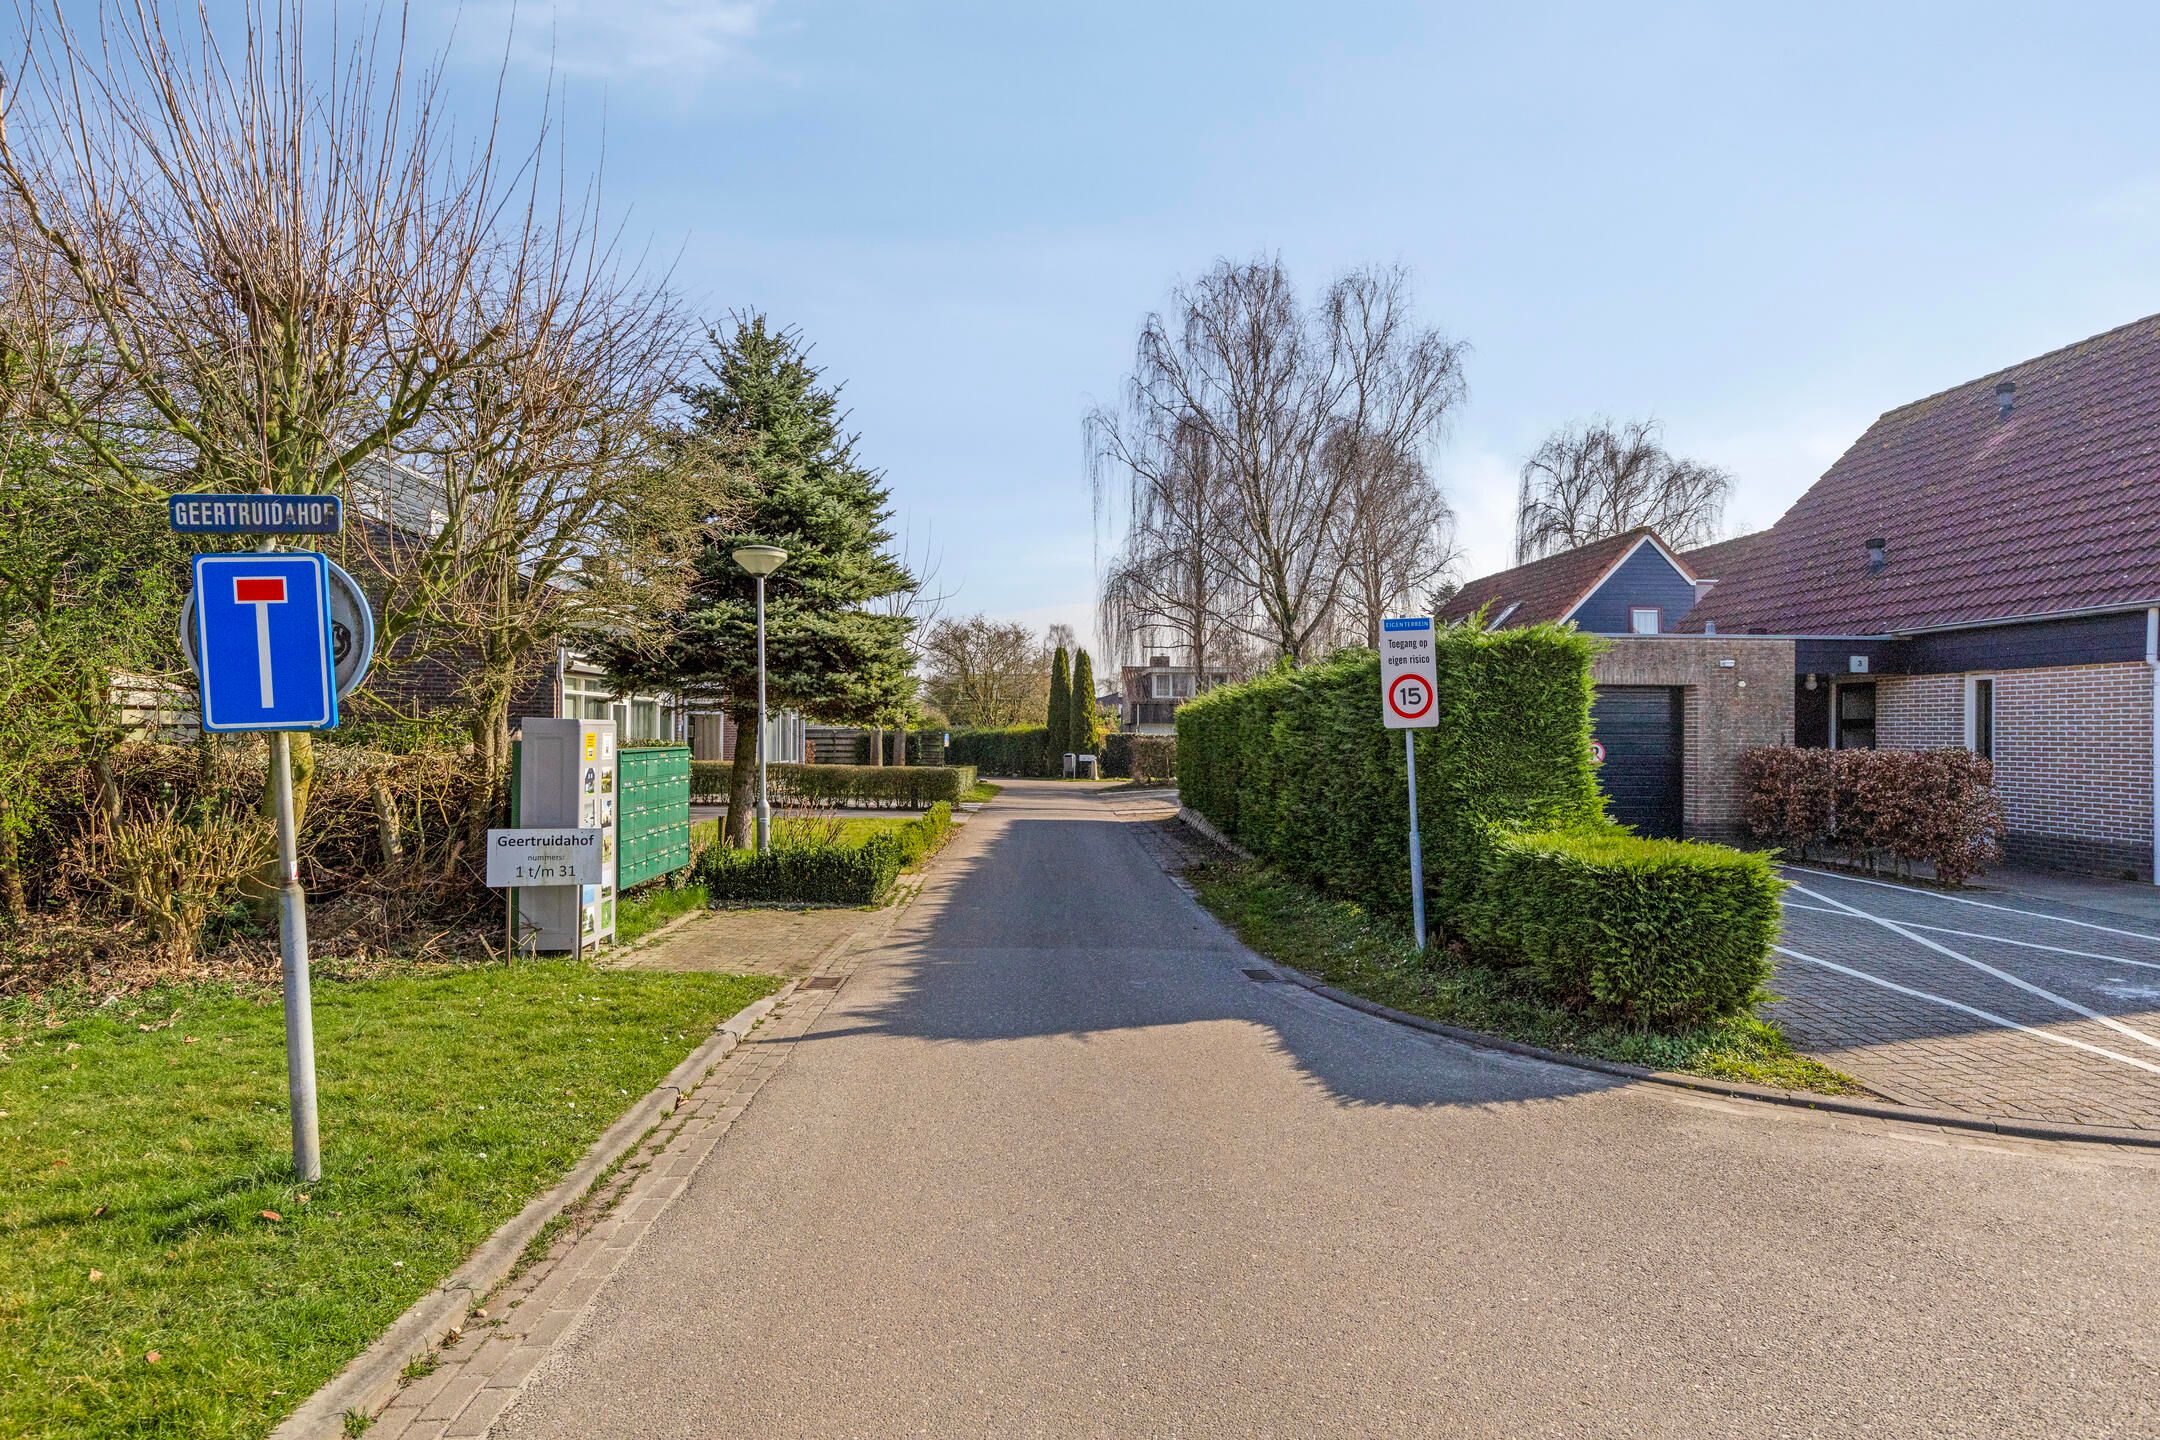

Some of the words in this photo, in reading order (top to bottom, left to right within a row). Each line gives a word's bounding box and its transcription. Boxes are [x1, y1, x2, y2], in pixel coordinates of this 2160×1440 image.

[175, 501, 334, 526] GEERTRUIDAHOF
[1388, 639, 1418, 650] Toegang
[1419, 639, 1428, 649] op
[1388, 655, 1408, 667] eigen
[1409, 654, 1430, 664] risico
[1400, 687, 1421, 706] 15
[497, 834, 594, 847] Geertruidahof
[515, 866, 524, 878] 1
[528, 865, 554, 879] t/m
[559, 865, 576, 877] 31
